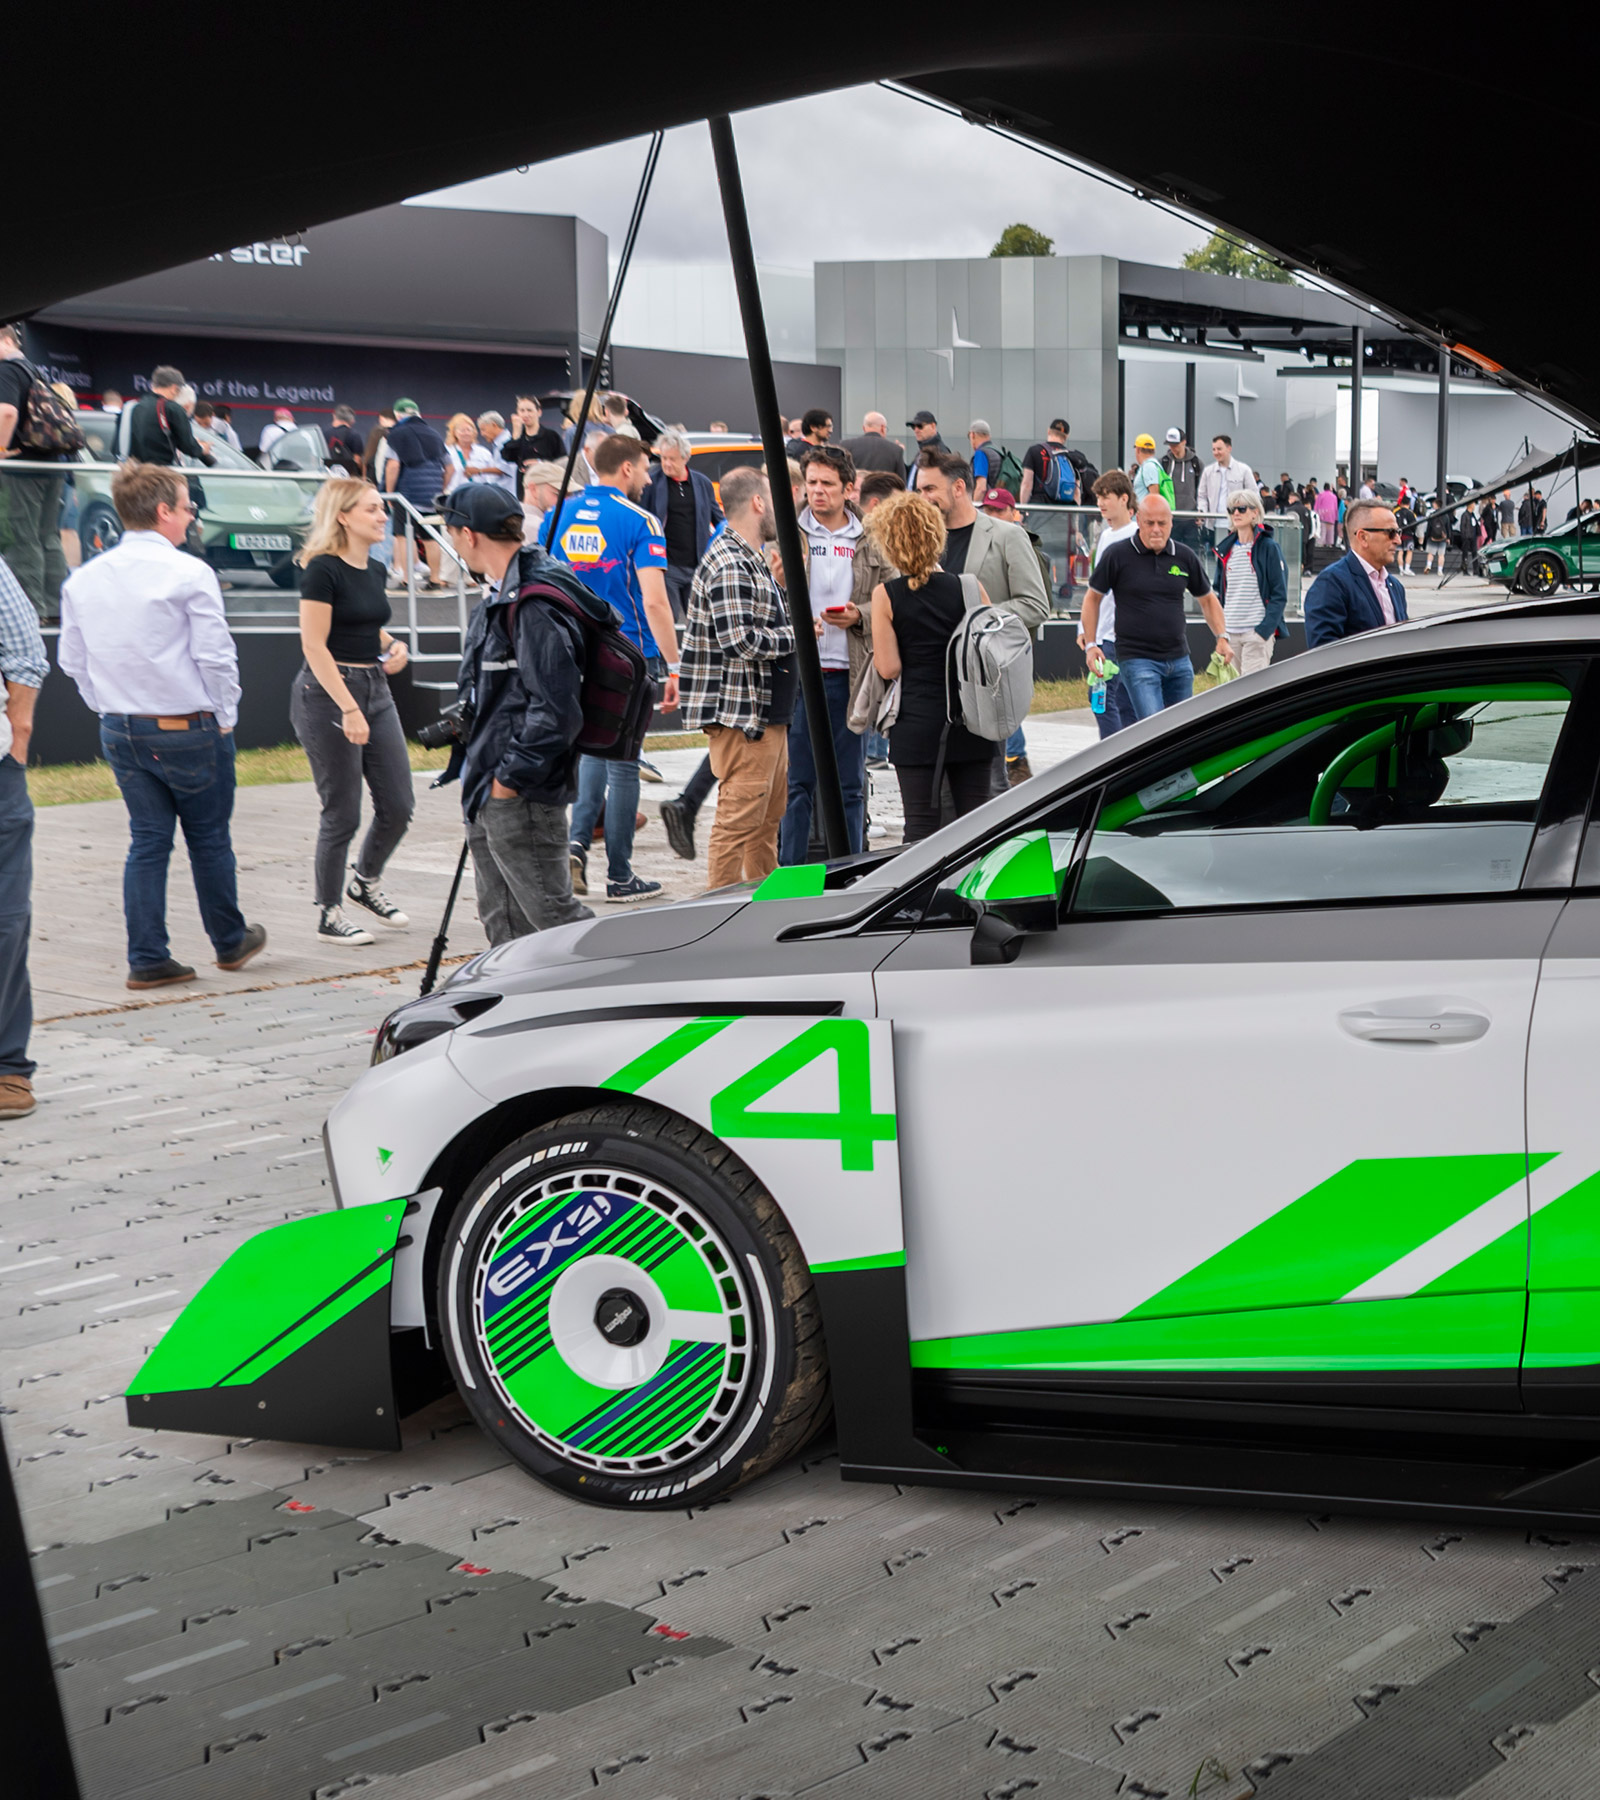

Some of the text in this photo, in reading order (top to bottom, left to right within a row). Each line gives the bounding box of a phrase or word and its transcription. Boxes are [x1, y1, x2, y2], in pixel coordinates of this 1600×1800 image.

[203, 379, 224, 397] of
[227, 380, 260, 398] the
[263, 381, 335, 404] Legend
[568, 534, 600, 553] NAPA
[833, 545, 855, 560] MOTO
[709, 1018, 898, 1172] 4
